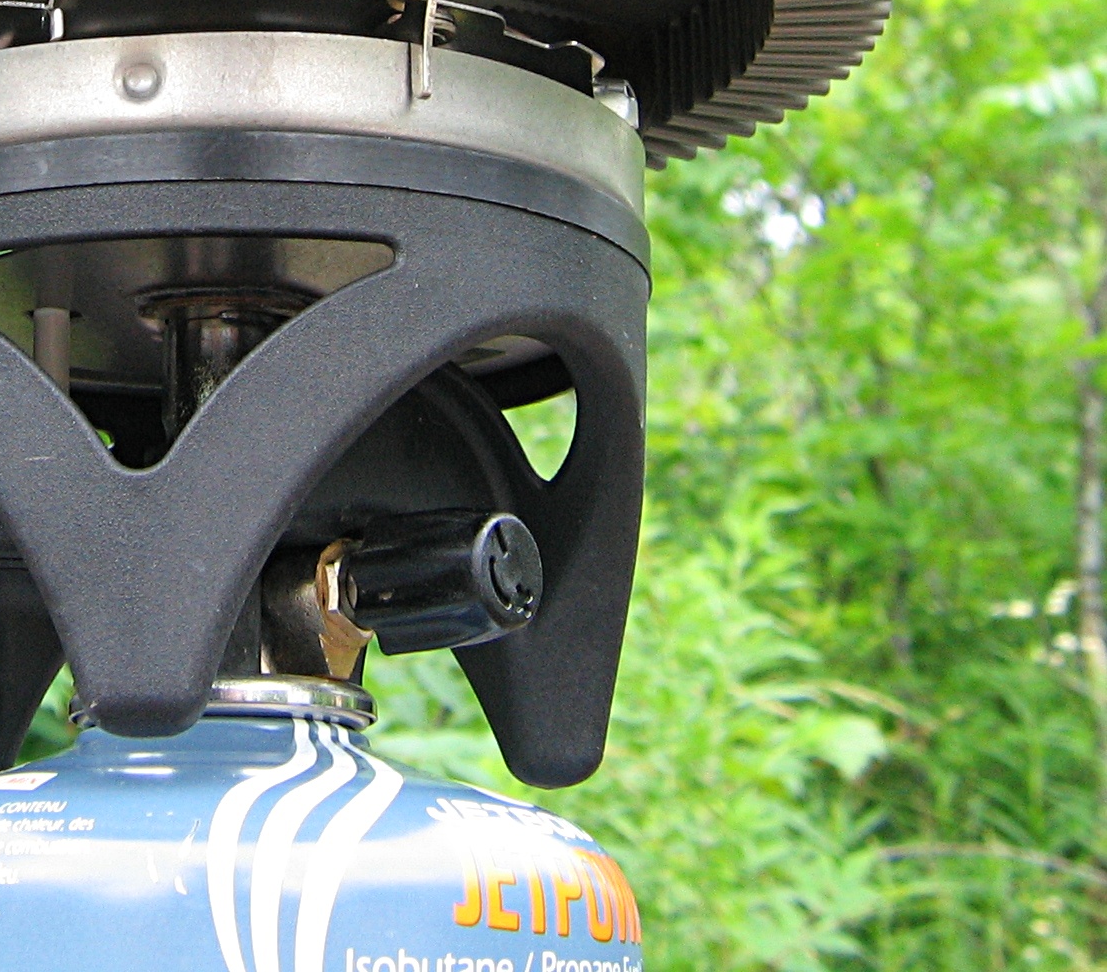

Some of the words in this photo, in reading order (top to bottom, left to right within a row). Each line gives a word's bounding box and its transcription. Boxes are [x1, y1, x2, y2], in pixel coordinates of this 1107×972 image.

[69, 817, 95, 831] des
[345, 948, 514, 972] Isobutane
[541, 950, 620, 972] Propane
